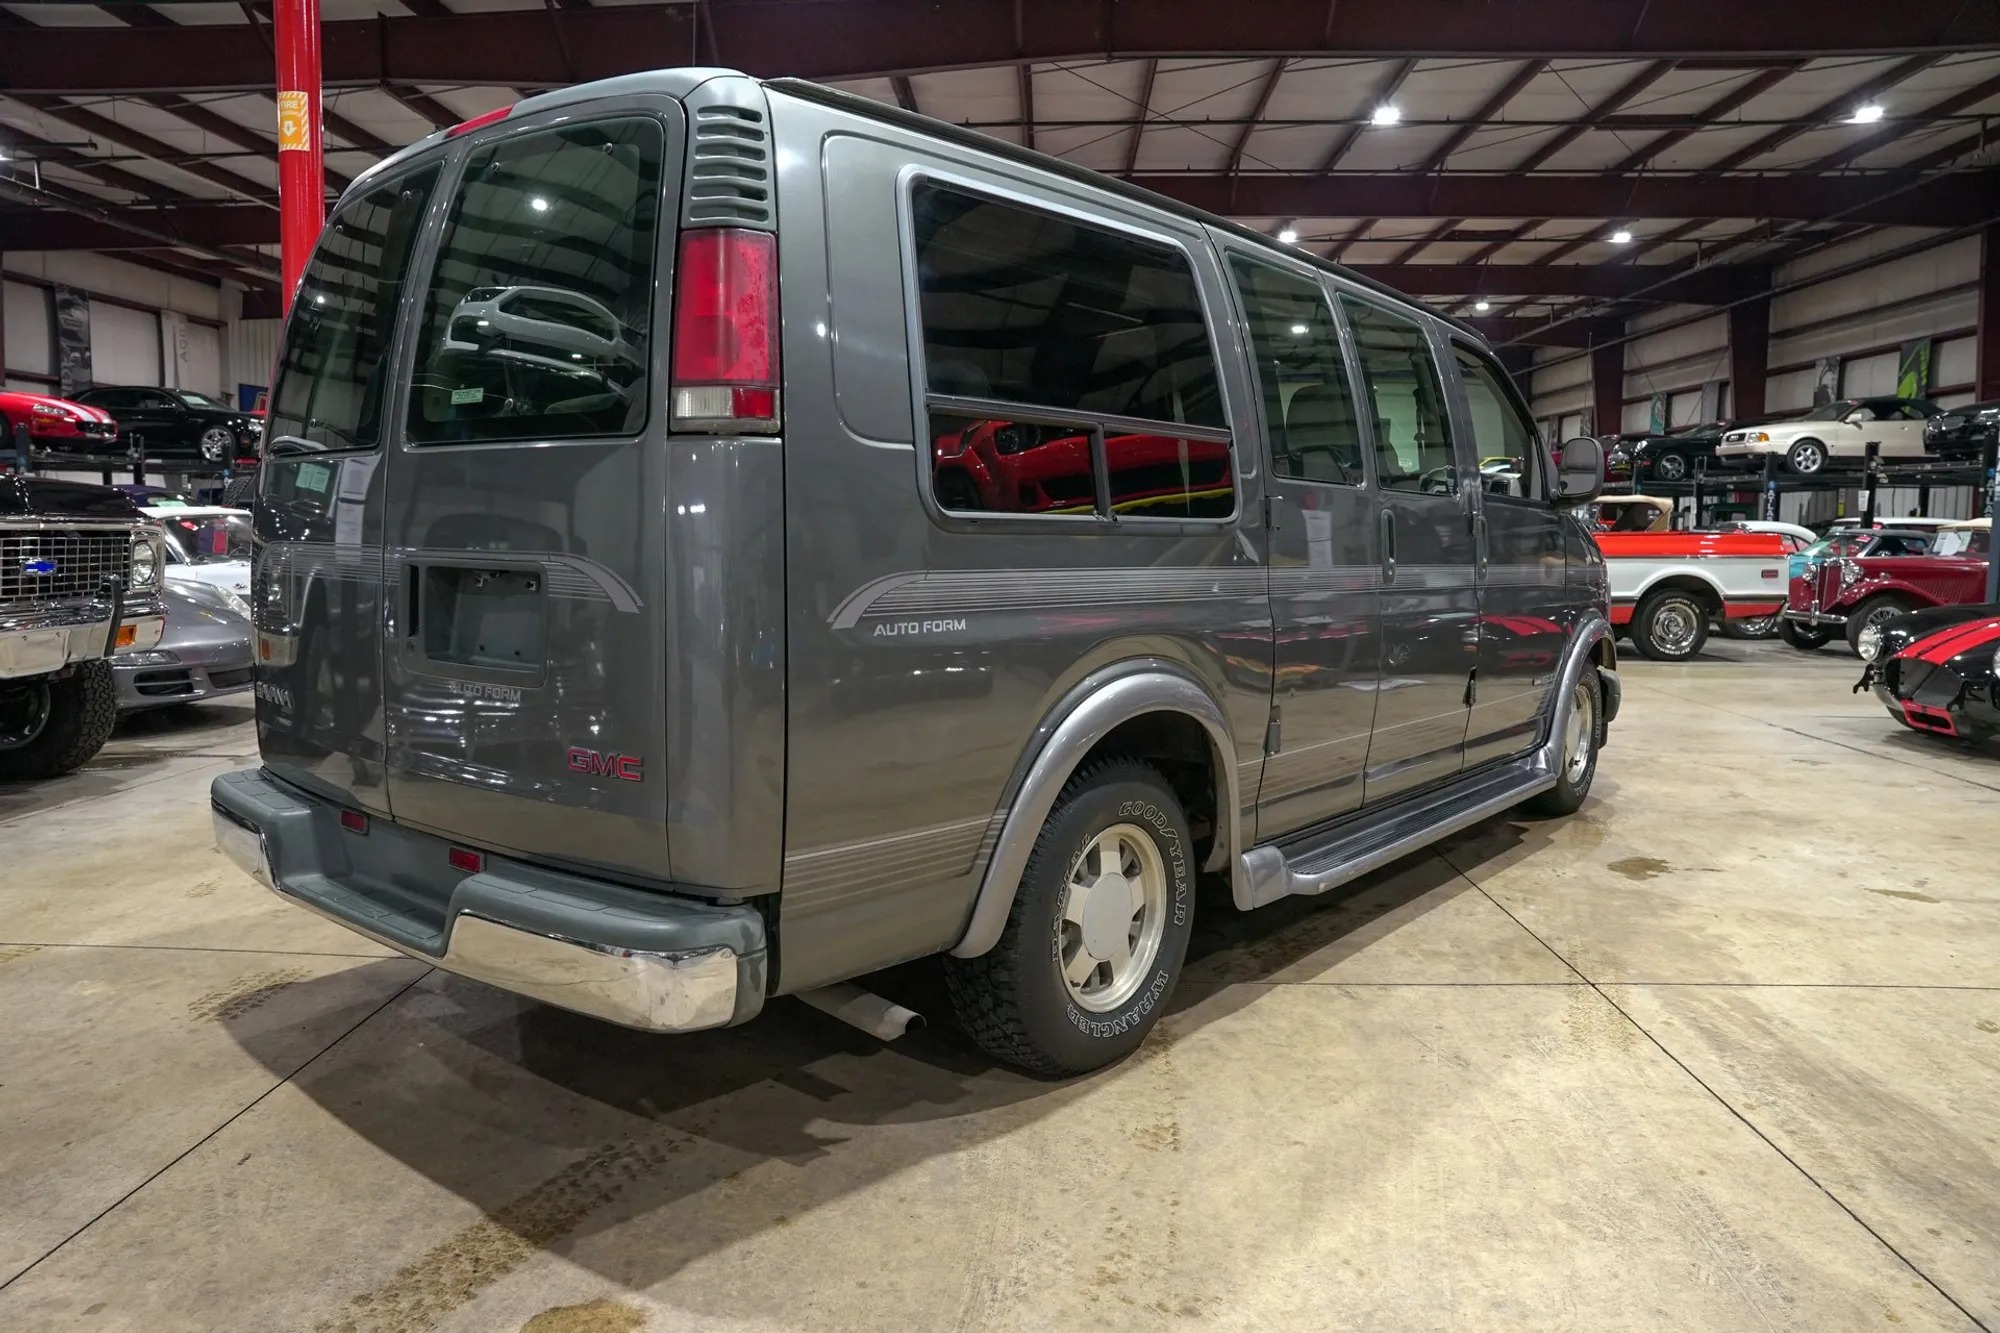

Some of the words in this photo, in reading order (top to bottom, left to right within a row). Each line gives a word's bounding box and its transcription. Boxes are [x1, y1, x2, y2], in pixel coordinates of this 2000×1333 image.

[873, 622, 919, 636] AUTO
[923, 618, 966, 633] FORM
[449, 681, 482, 697] AUTO
[485, 687, 521, 702] FORM
[567, 746, 644, 782] GMC
[1119, 801, 1187, 926] GOODYEAR
[1066, 970, 1169, 1038] WRANGLER
